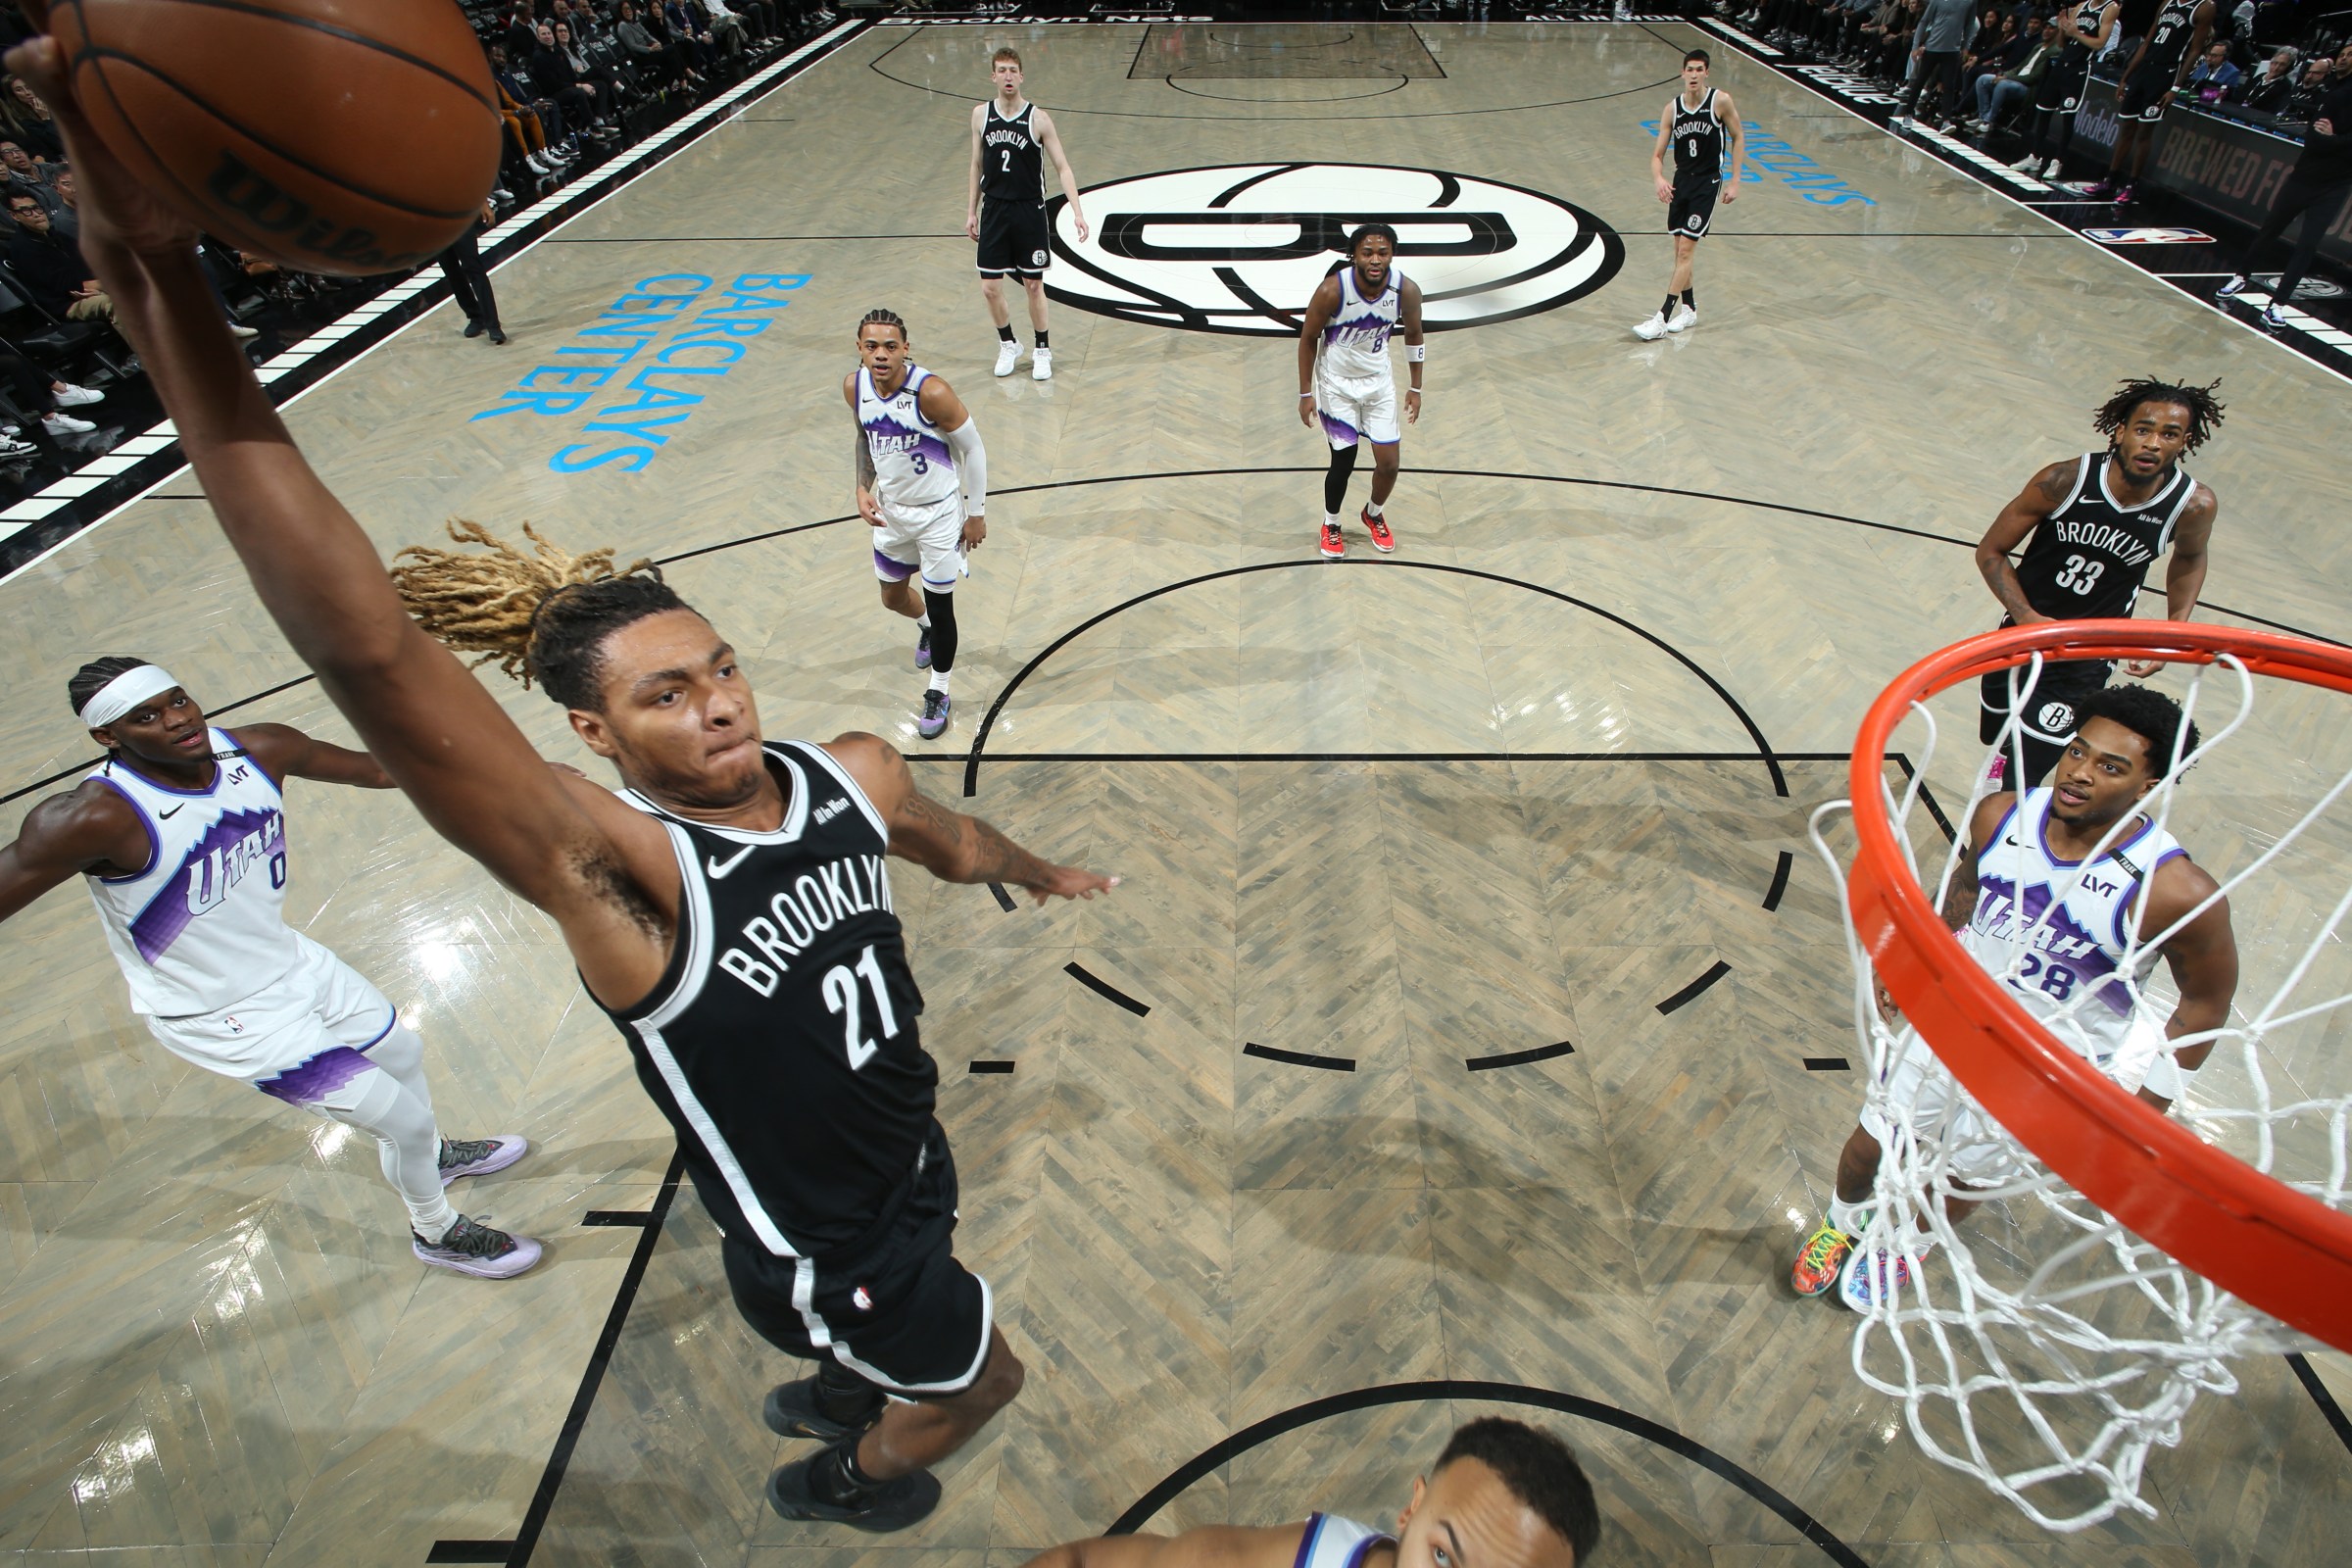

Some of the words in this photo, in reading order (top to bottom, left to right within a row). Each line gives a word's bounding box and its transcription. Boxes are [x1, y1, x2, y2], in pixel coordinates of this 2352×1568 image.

[877, 16, 1089, 25] Brooklyn
[2154, 26, 2171, 44] 20
[985, 129, 1028, 150] BROOKLYN
[1673, 121, 1713, 139] BROOKLYN
[1002, 150, 1010, 172] 2
[1689, 139, 1697, 157] 8
[2157, 125, 2263, 200] BREWED
[468, 273, 714, 422] CENTER
[1336, 322, 1393, 348] UTAH
[1372, 337, 1383, 353] 8
[548, 273, 814, 472] BARCLAYS
[897, 401, 912, 410] LVT
[865, 430, 921, 459] UTAH
[910, 452, 928, 475] 3
[2056, 520, 2151, 566] BROOKLYN
[2055, 554, 2105, 596] 33
[226, 764, 250, 786] LVT
[186, 810, 281, 916] UTAH
[270, 851, 286, 889] 0
[2081, 873, 2119, 898] LVT
[717, 854, 895, 999] BROOKLYN
[1971, 885, 2104, 959] UTAH
[821, 944, 901, 1071] 21
